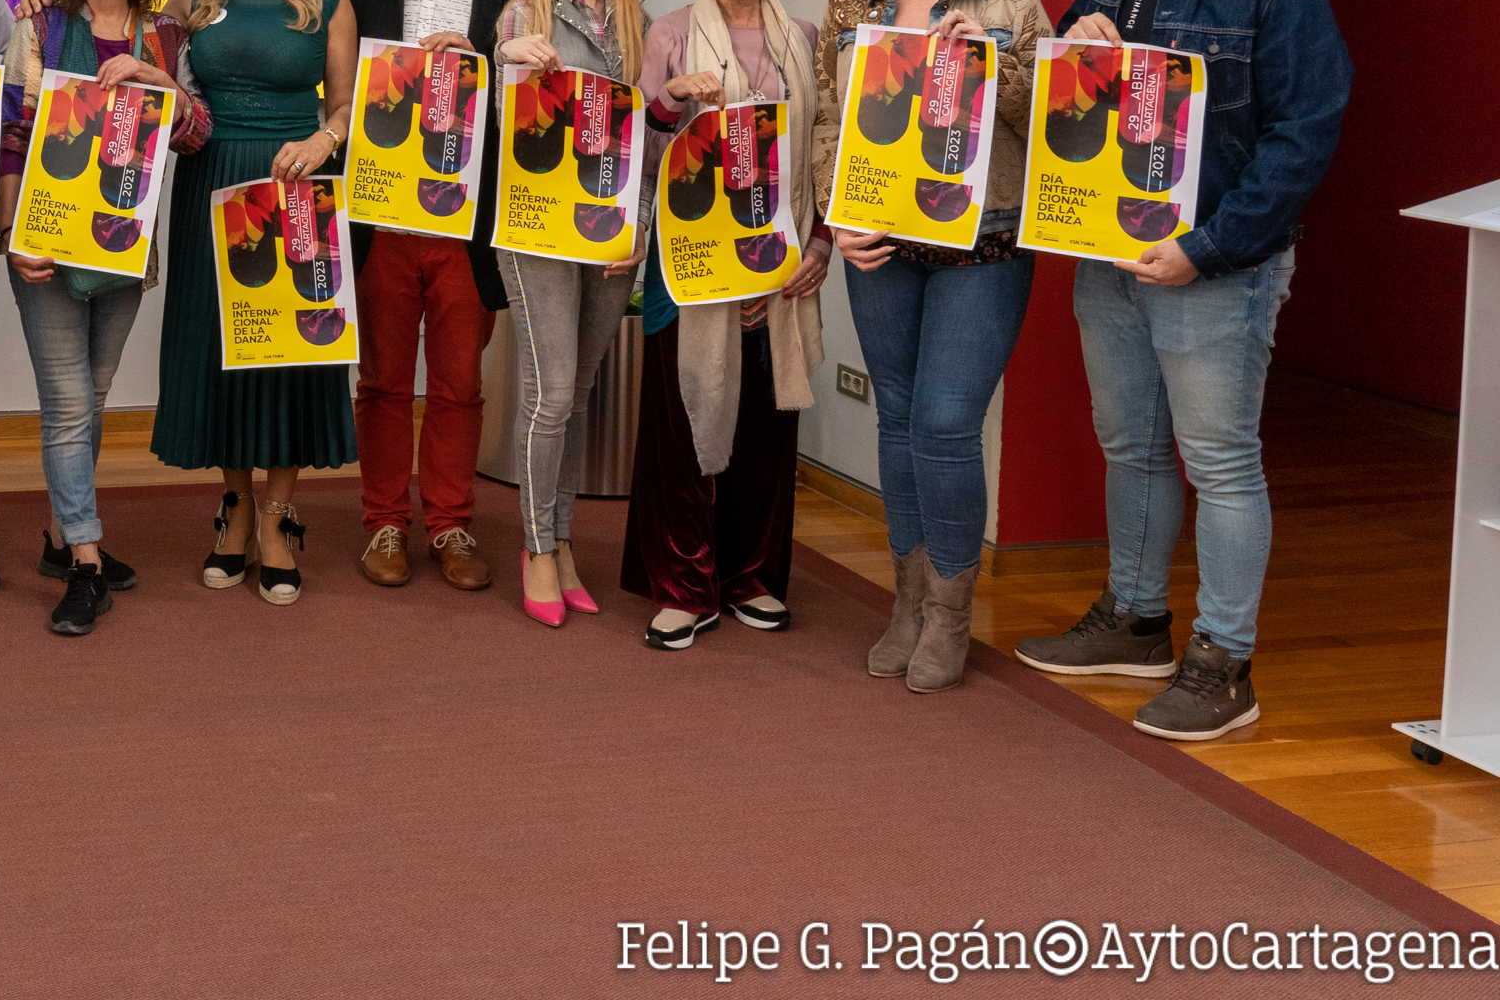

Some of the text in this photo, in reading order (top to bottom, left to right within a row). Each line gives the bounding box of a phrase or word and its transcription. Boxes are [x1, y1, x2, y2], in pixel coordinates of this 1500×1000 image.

[933, 48, 947, 85] ABRIL
[431, 61, 442, 95] ABRIL
[1131, 61, 1144, 100] ABRIL
[942, 61, 956, 117] CARTAGENA
[440, 72, 451, 123] CARTAGENA
[583, 82, 593, 117] ABRIL
[1143, 74, 1157, 133] CARTAGENA
[112, 96, 126, 129] ABRIL
[594, 93, 604, 145] CARTAGENA
[120, 107, 134, 157] CARTAGENA
[729, 118, 739, 153] ABRIL
[446, 134, 457, 162] 2023
[948, 130, 962, 161] 2023
[742, 127, 751, 179] CARTAGENA
[358, 157, 376, 167] DÍA
[850, 155, 870, 165] DÍA
[1152, 146, 1166, 178] 2023
[357, 167, 406, 179] INTERNA-
[603, 157, 614, 185] 2023
[849, 165, 902, 179] INTERNA-
[123, 169, 136, 197] 2023
[356, 175, 394, 186] CIONAL
[848, 174, 889, 187] CIONAL
[1041, 173, 1063, 184] DÍA
[33, 189, 51, 199] DÍA
[355, 183, 384, 194] DE LA
[511, 184, 529, 193] DÍA
[846, 183, 878, 195] DE LA
[1040, 183, 1102, 198] INTERNA-
[354, 191, 389, 203] DANZA
[510, 194, 562, 205] INTERNA-
[754, 186, 763, 214] 2023
[845, 192, 884, 206] DANZA
[1039, 193, 1087, 206] CIONAL
[31, 198, 81, 212] INTERNA-
[287, 190, 298, 224] ABRIL
[509, 202, 550, 212] CIONAL
[1038, 202, 1075, 215] DE LA
[30, 206, 68, 219] CIONAL
[509, 211, 540, 221] DE LA
[1038, 212, 1082, 226] DANZA
[28, 214, 58, 226] DE LA
[300, 200, 311, 251] CARTAGENA
[509, 219, 546, 230] DANZA
[26, 223, 63, 236] DANZA
[671, 235, 690, 246] DÍA
[672, 240, 721, 254] INTERNA-
[672, 250, 712, 263] CIONAL
[674, 260, 705, 272] DE LA
[316, 261, 326, 288] 2023
[676, 268, 714, 281] DANZA
[232, 300, 251, 309] DÍA
[233, 309, 282, 318] INTERNA-
[233, 318, 273, 326] CIONAL
[235, 335, 272, 344] DANZA
